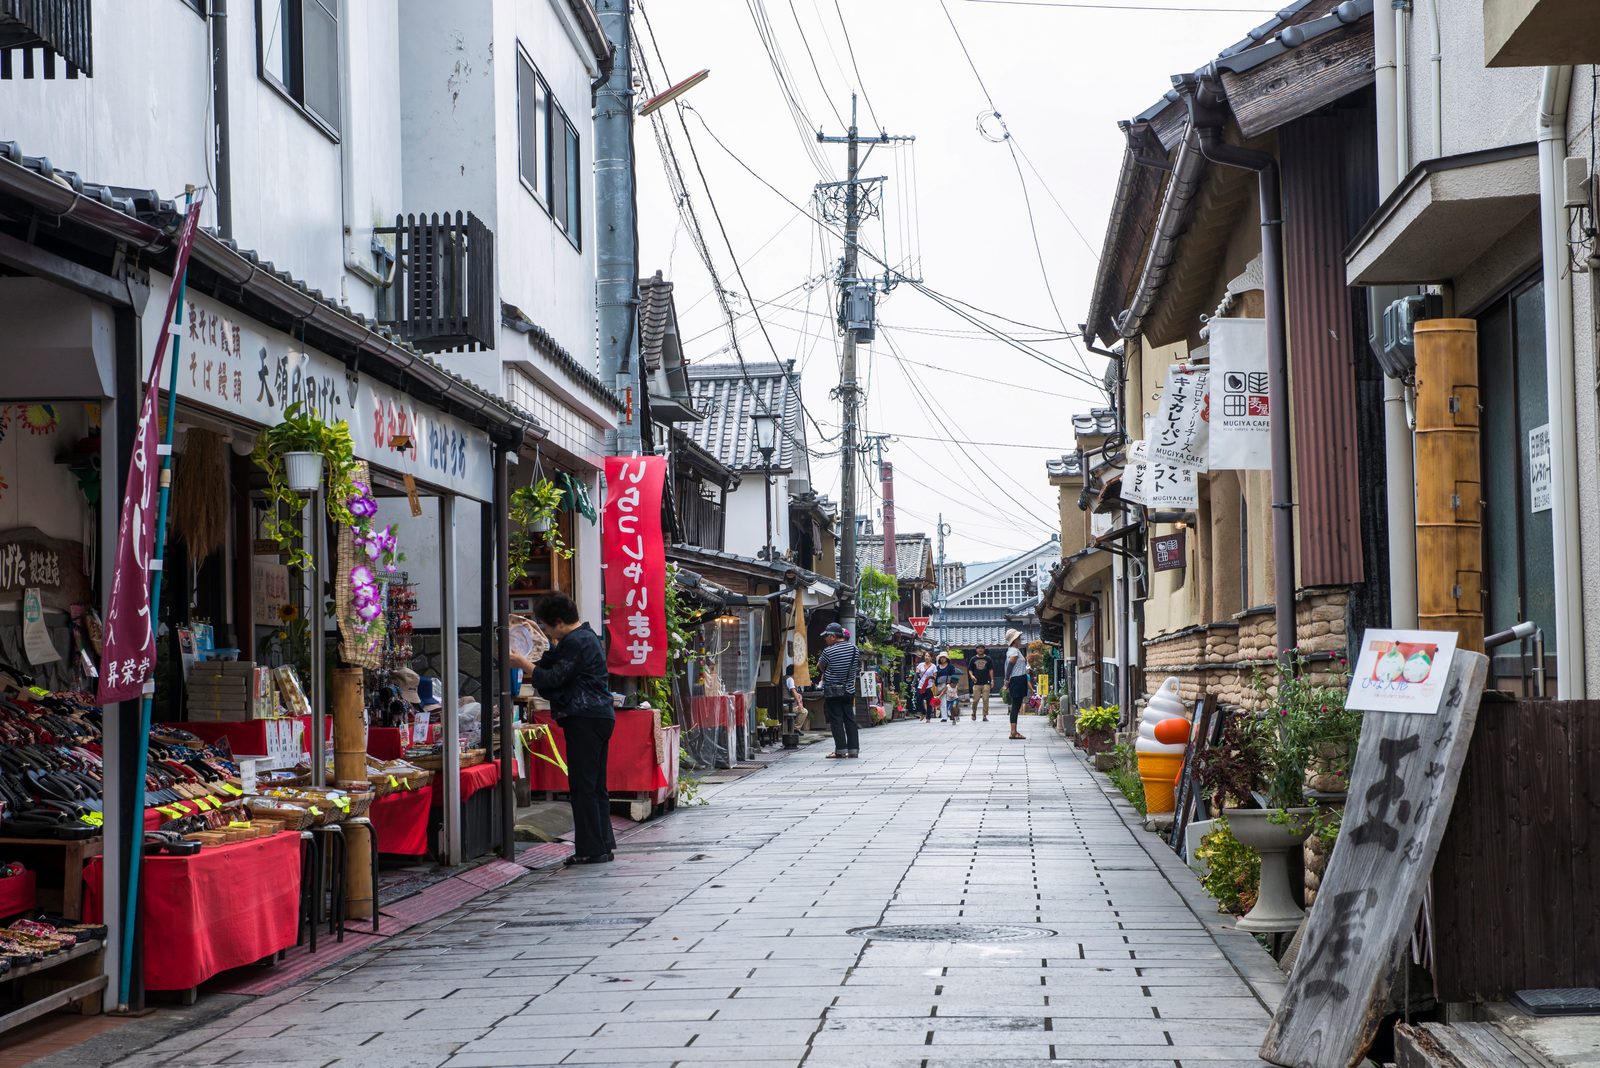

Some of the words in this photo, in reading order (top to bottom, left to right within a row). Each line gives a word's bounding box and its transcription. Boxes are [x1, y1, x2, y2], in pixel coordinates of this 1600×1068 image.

[1161, 376, 1190, 447] キーマカレーパン
[1155, 447, 1184, 460] MUGIYA
[1186, 455, 1204, 464] CAFE
[0, 543, 26, 590] げた
[107, 656, 151, 689] 昇栄堂
